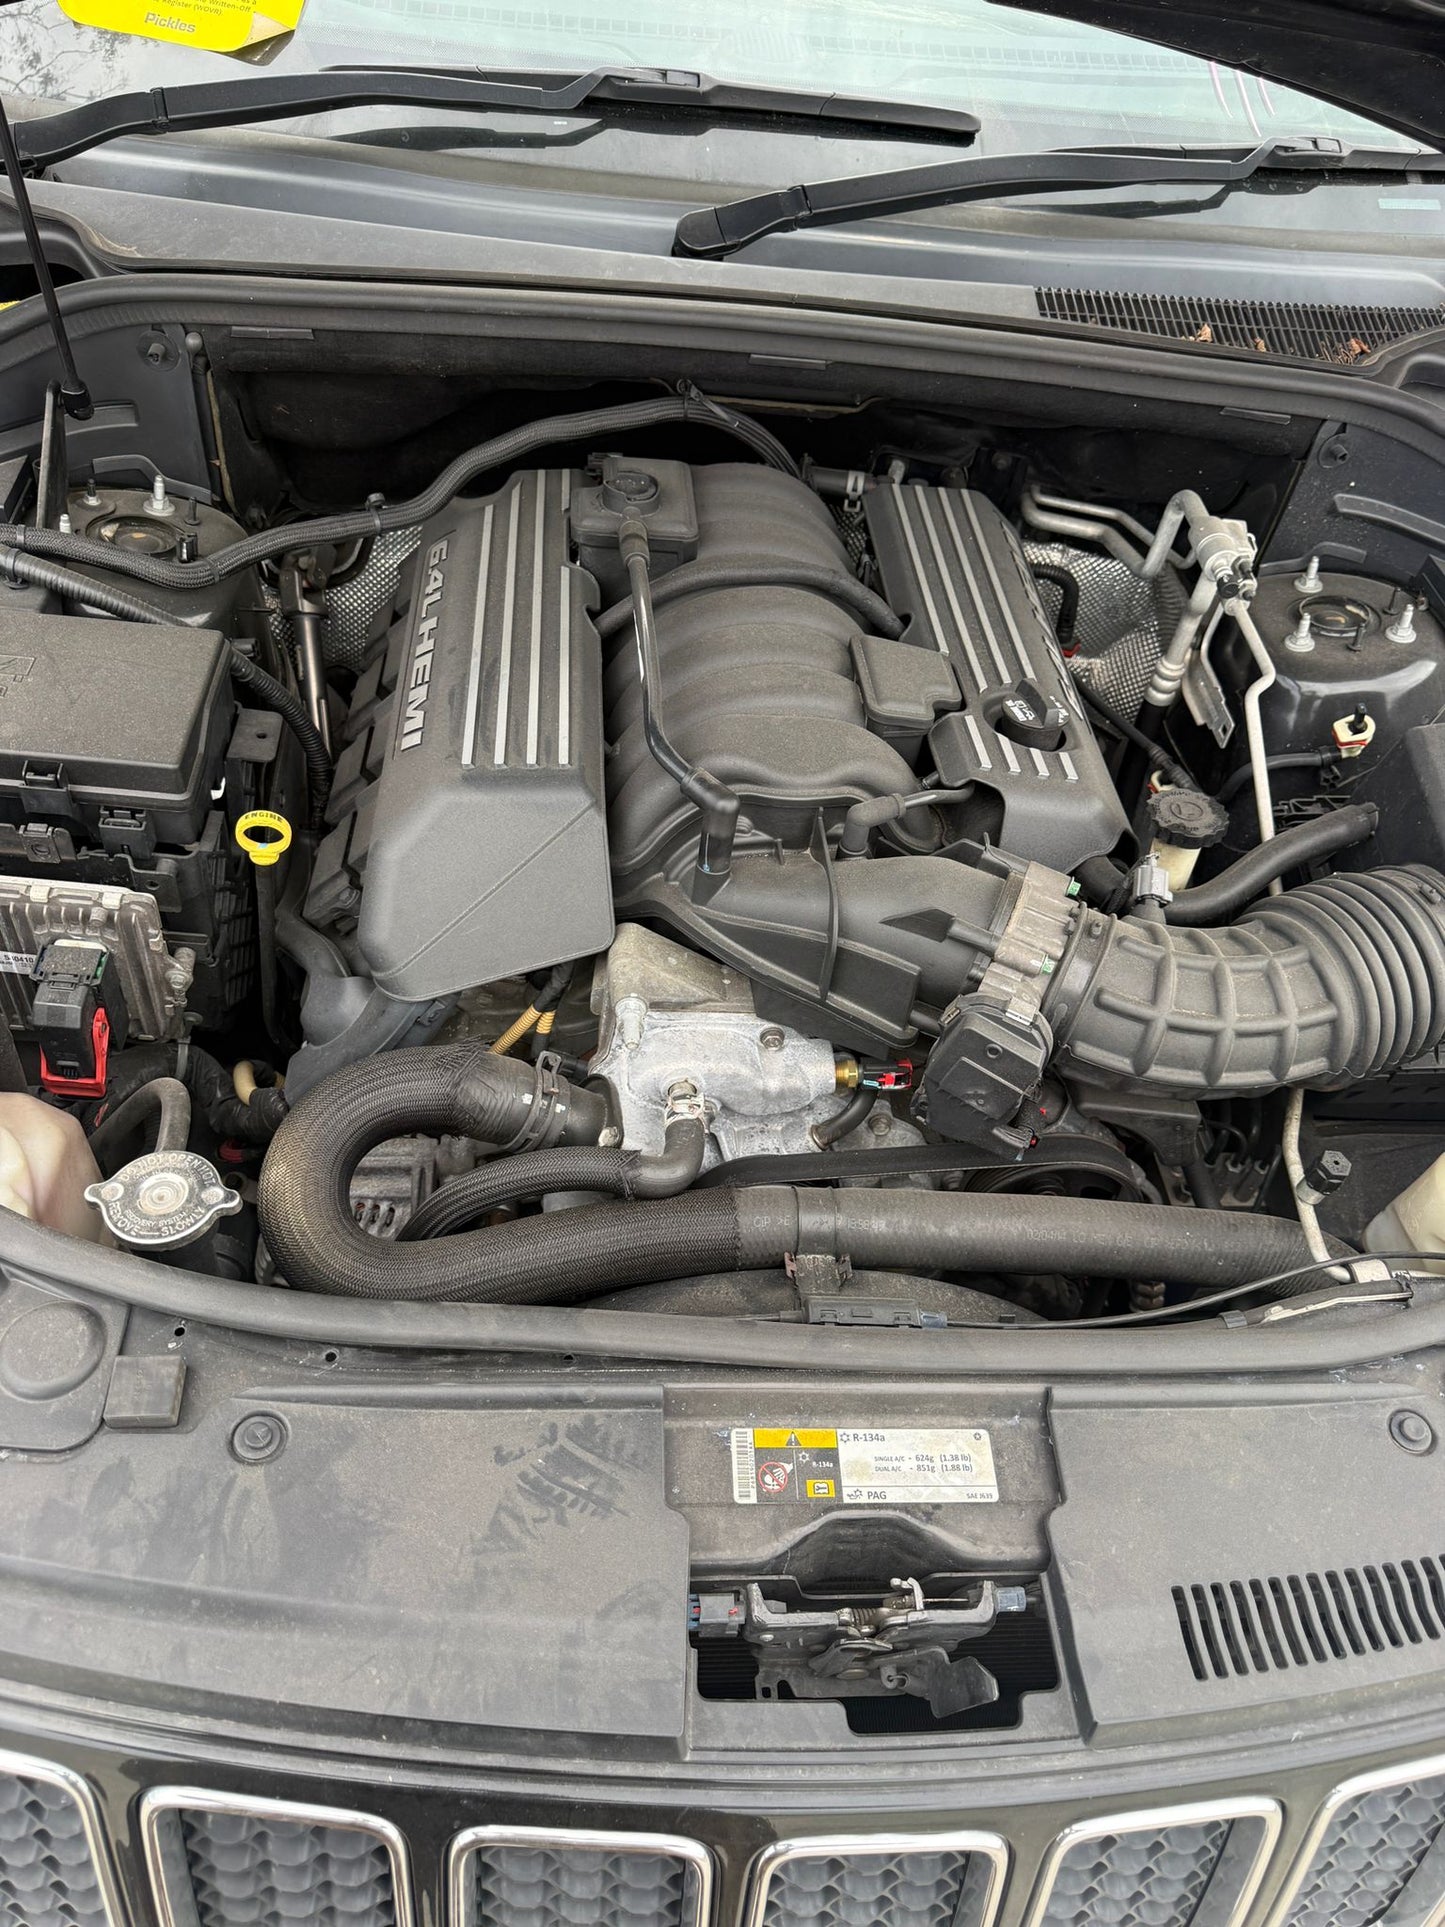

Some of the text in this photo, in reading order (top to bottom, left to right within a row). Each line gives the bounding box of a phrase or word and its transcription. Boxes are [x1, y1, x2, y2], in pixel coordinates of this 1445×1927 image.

[144, 11, 197, 33] Pickles
[400, 616, 440, 751] HEMI
[244, 811, 283, 823] ENGINE
[169, 1153, 202, 1168] OPEN
[108, 1200, 206, 1236] REMOVE SLOWLY
[159, 1211, 187, 1227] SYSTEM
[852, 1432, 886, 1442] R-134a
[874, 1455, 894, 1463] SINGLE
[894, 1455, 905, 1463] A/C
[915, 1454, 935, 1463] 624g
[939, 1453, 959, 1463] (1.38
[960, 1453, 972, 1463] lb)
[812, 1460, 834, 1468] R-134a
[874, 1465, 890, 1473] DUAL
[891, 1465, 902, 1473] A/C
[916, 1464, 936, 1473] 851g
[941, 1464, 961, 1473] (1.88
[962, 1464, 973, 1473] lb)
[867, 1490, 887, 1500] PAG
[966, 1492, 978, 1500] SAE
